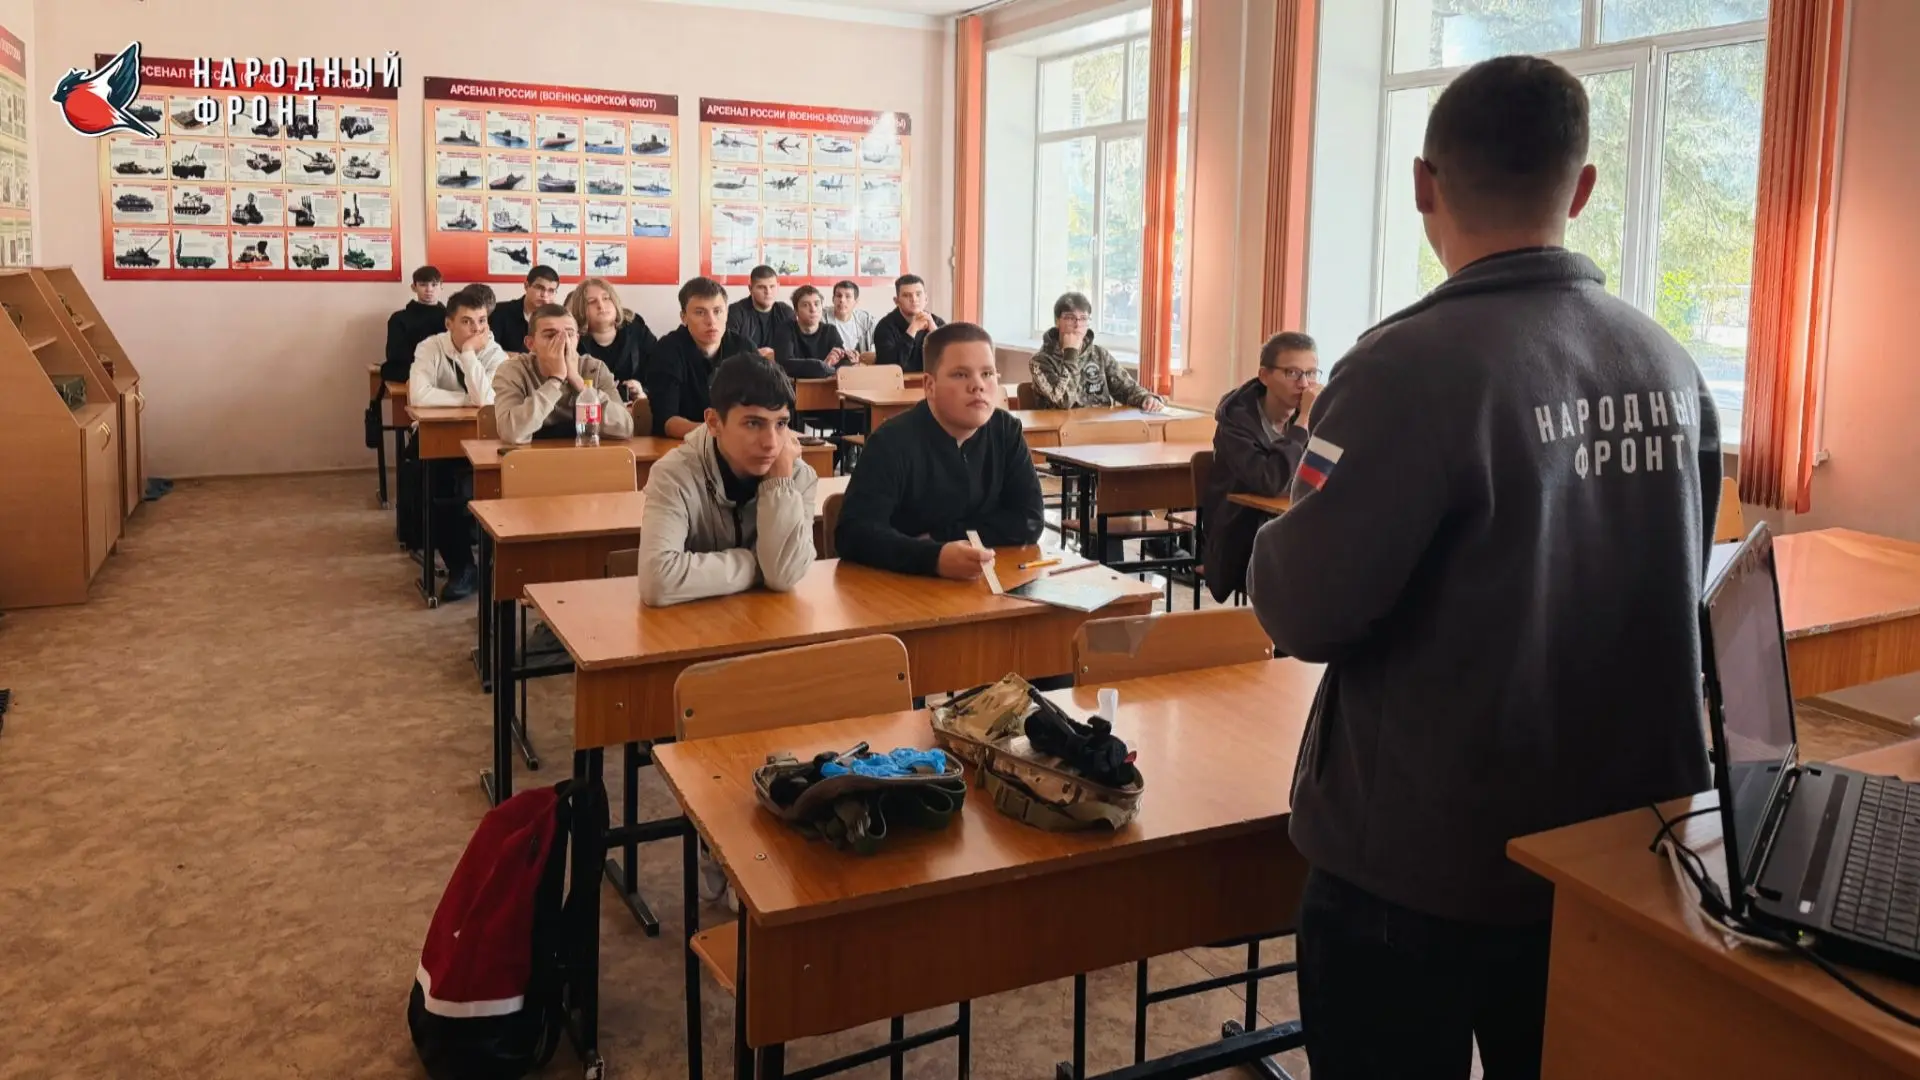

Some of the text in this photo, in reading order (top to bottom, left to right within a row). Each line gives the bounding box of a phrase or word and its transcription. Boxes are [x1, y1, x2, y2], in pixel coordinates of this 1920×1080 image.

[140, 65, 187, 79] РСЕНАЛ
[450, 84, 657, 111] АРСЕНАЛ РОССИИ (ВОЕННО-МОРСКОЙ ФЛОТ)
[707, 104, 749, 117] АРСЕНАЛ
[750, 108, 786, 119] РОССИИ
[1574, 435, 1685, 479] ФРОНТ
